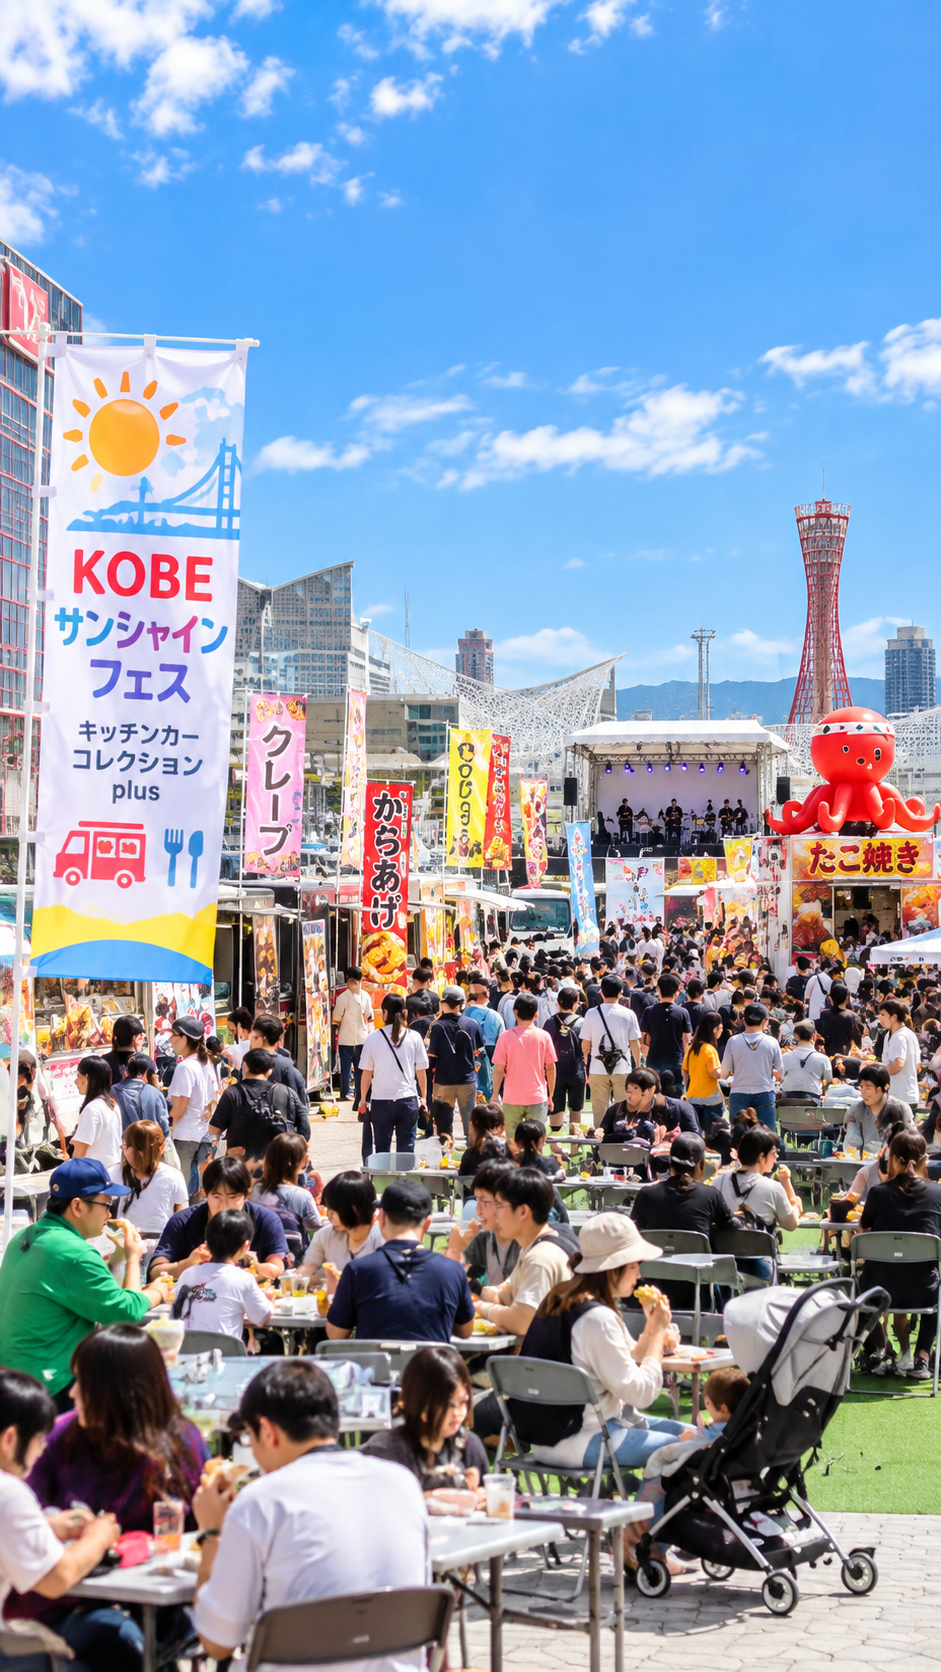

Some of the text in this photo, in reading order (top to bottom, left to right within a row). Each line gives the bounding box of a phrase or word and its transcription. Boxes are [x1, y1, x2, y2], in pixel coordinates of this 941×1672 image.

[73, 549, 214, 602] KOBE
[54, 607, 229, 654] サンシャイン
[90, 658, 191, 704] フェス
[78, 720, 200, 747] キッチンカー
[72, 749, 203, 776] コレクション
[112, 780, 160, 804] plus
[259, 724, 293, 857] クレープ
[371, 790, 402, 930] からあげ
[809, 840, 920, 874] たこ焼き
